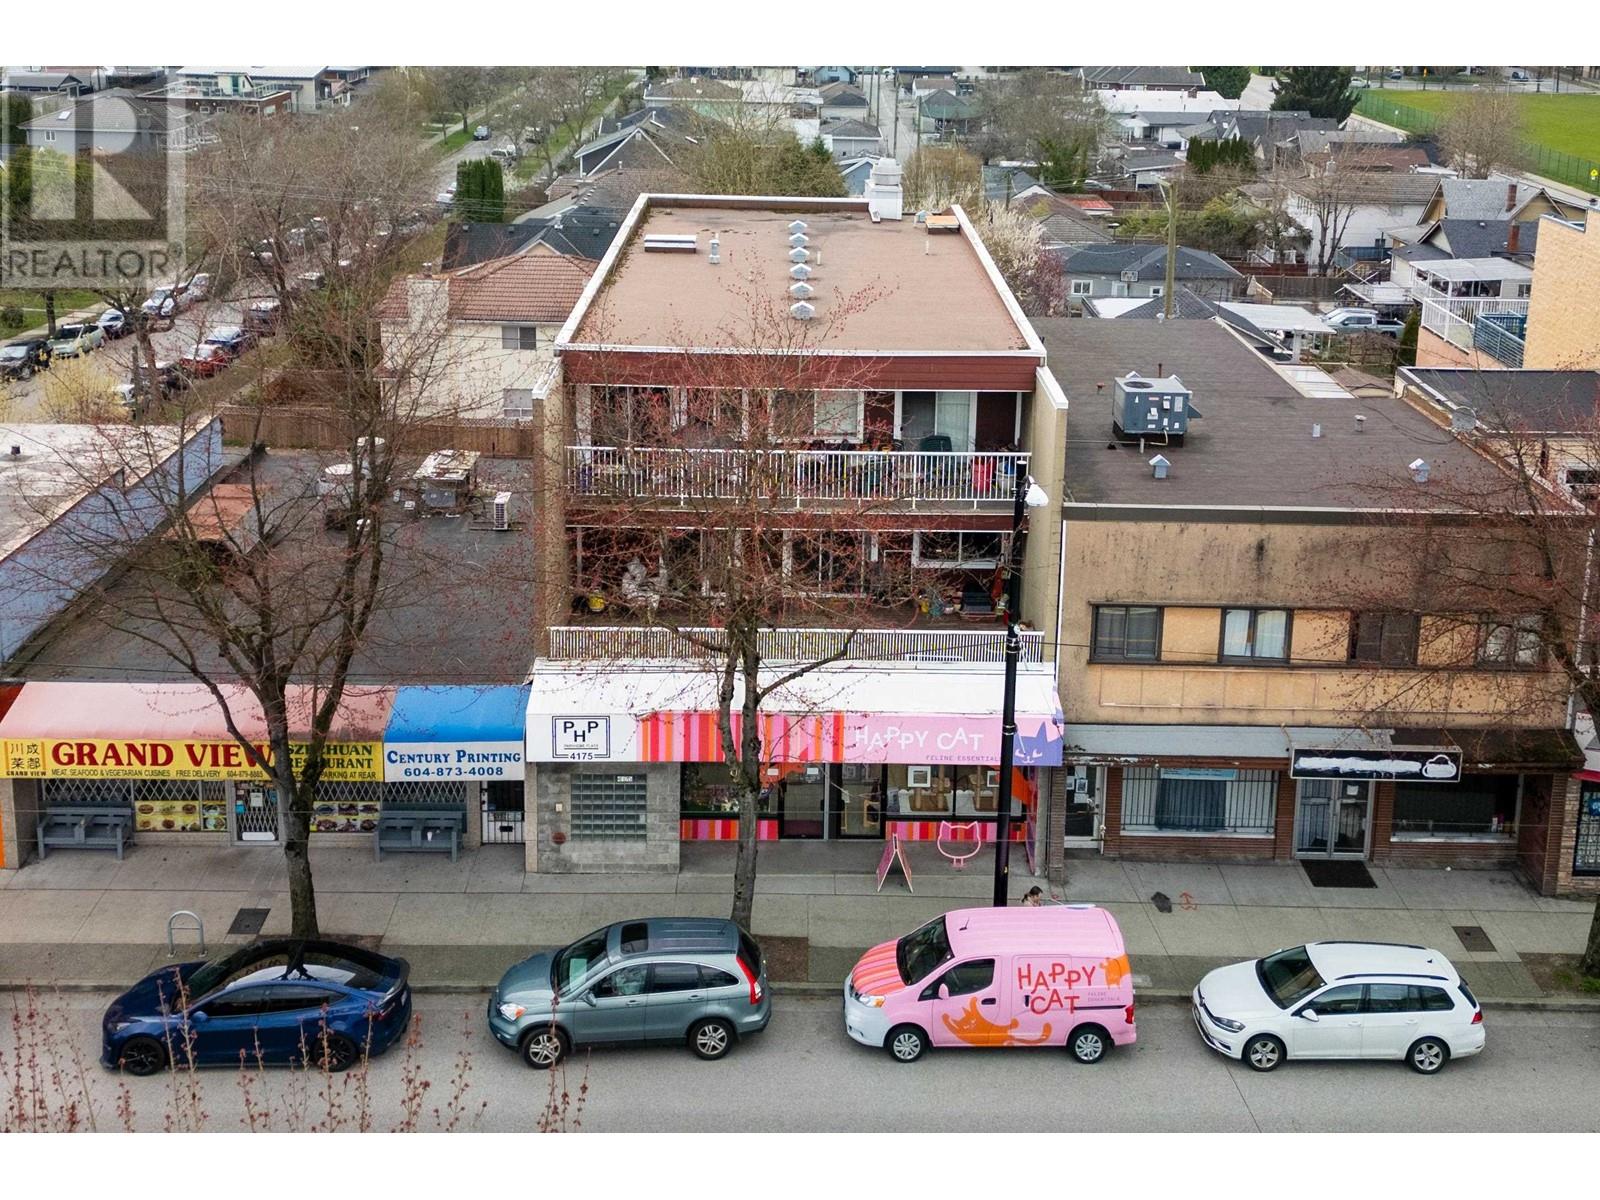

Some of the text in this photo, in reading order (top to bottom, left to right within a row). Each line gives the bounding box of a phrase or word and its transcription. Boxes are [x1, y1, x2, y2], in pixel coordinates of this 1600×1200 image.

[854, 726, 983, 751] HAPPY CAT
[51, 742, 273, 768] GRAND VIEW
[287, 744, 373, 755] SZHUAN
[387, 750, 521, 764] CENTURY PRINTING
[569, 752, 593, 760] 4175
[926, 754, 1002, 763] FELINE ESSENTIAL
[70, 769, 98, 777] SEAFOOD
[105, 769, 142, 777] VEGETARIAN
[144, 769, 171, 777] CUISINES
[175, 770, 191, 778] FREE
[192, 770, 221, 778] DELIVERY
[349, 771, 358, 779] AT
[360, 771, 377, 780] REAR
[404, 767, 504, 777] 604-873-4008
[1018, 962, 1096, 994] HAPPY
[1030, 988, 1080, 1014] CAT
